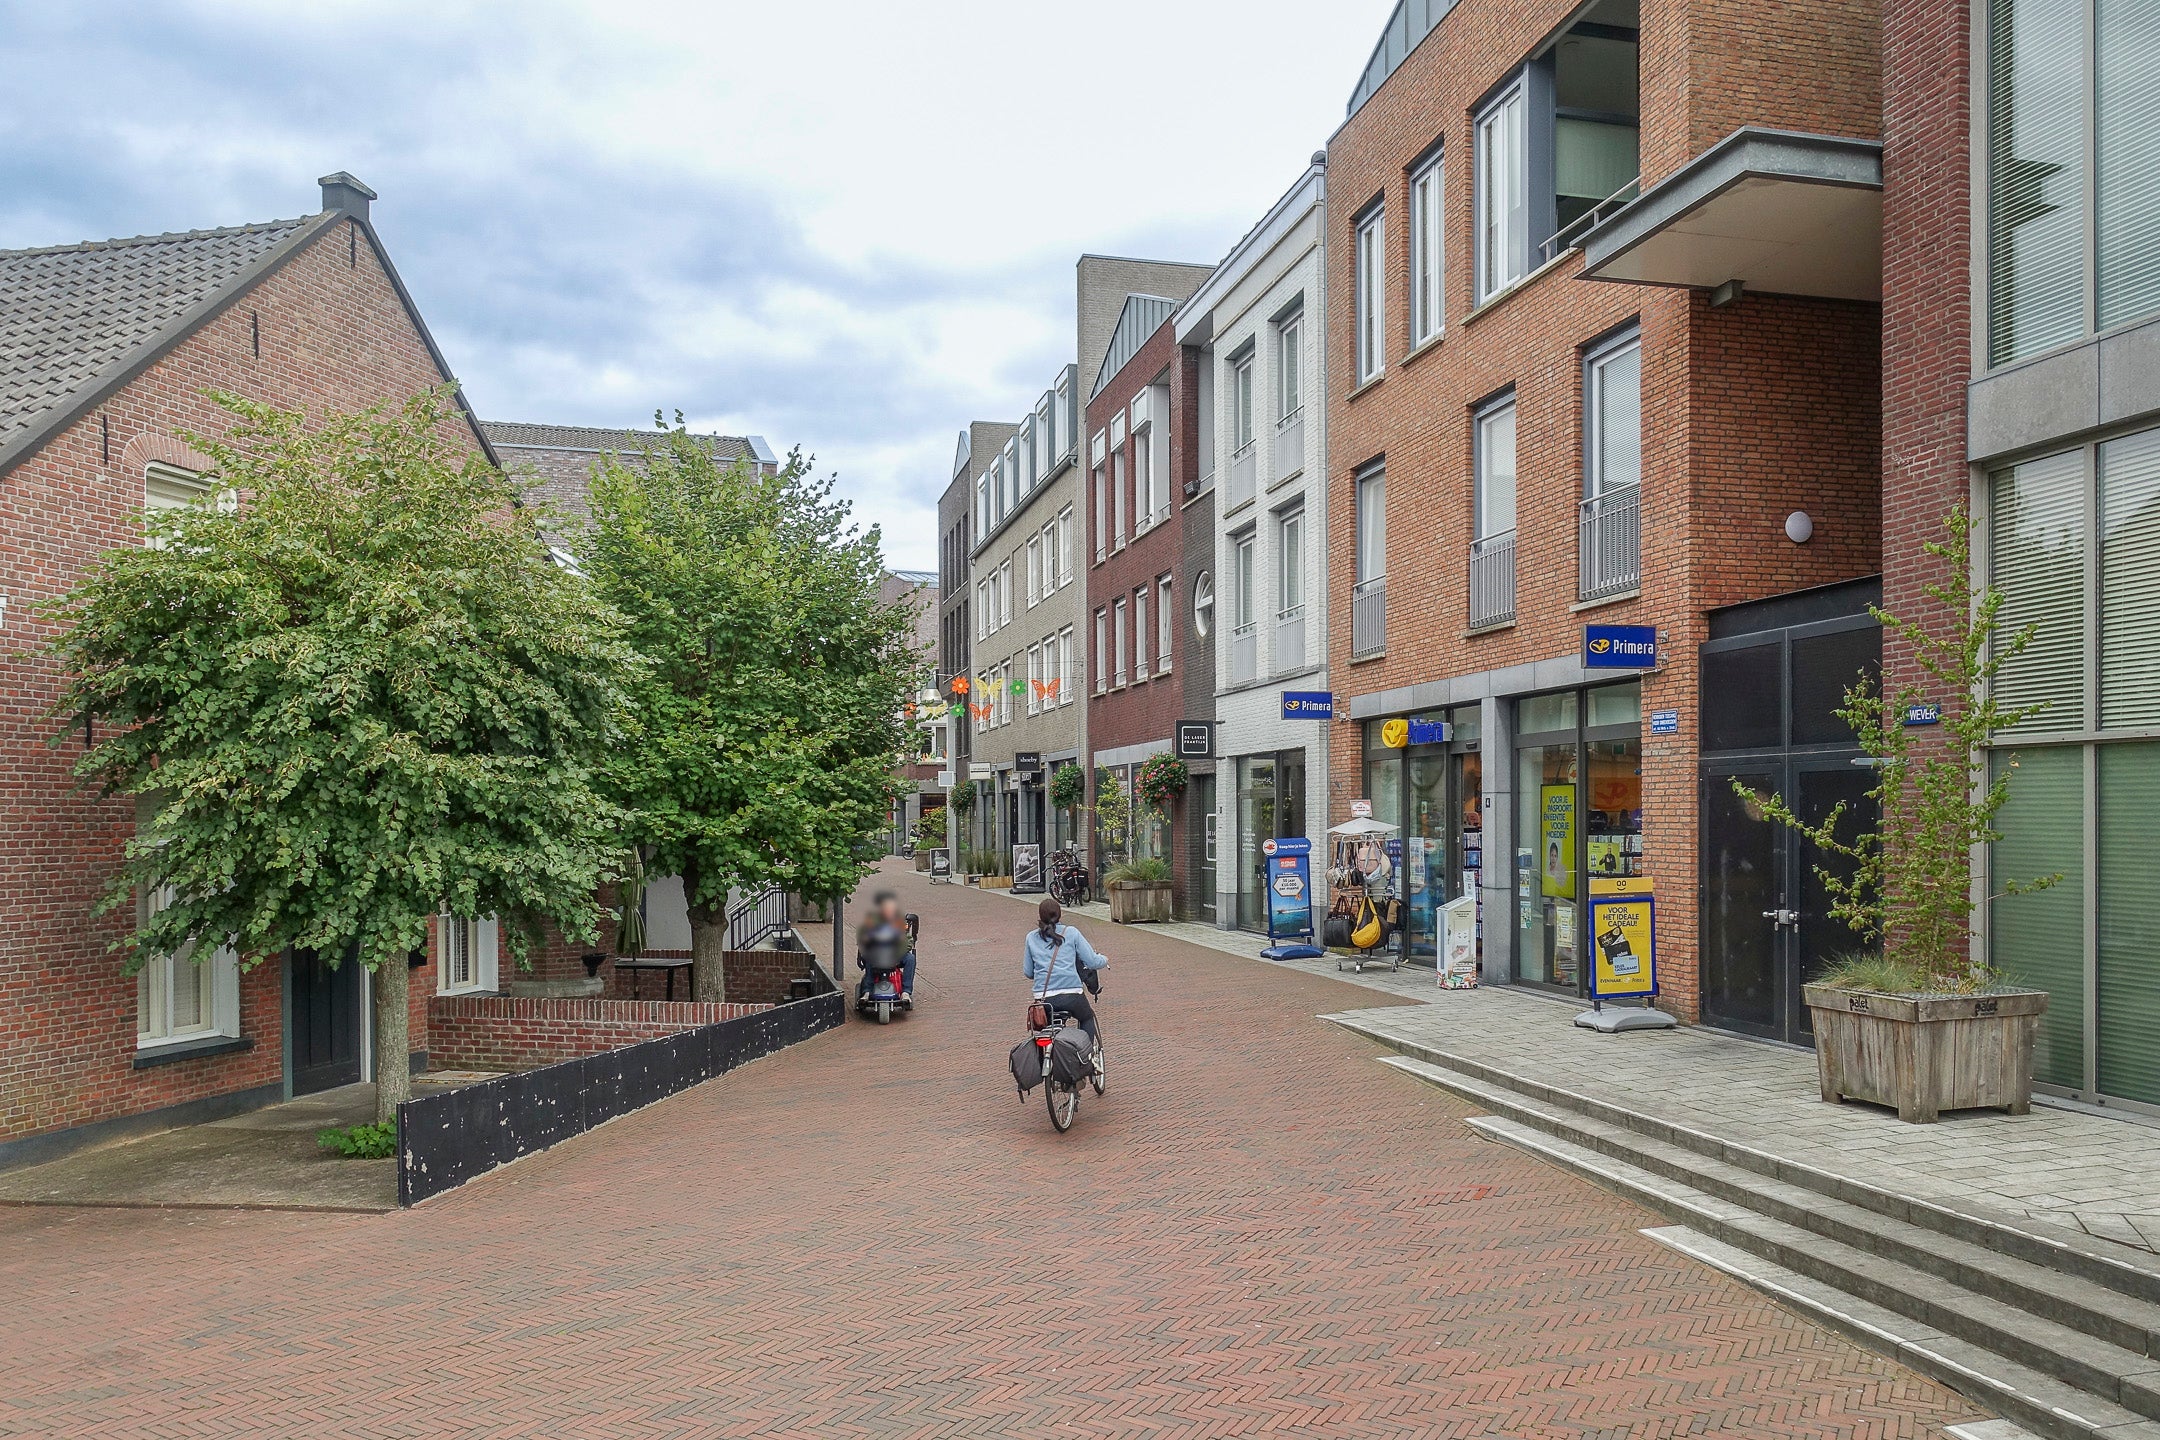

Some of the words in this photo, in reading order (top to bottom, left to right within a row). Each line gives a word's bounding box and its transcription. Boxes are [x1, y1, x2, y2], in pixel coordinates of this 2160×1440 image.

[1612, 639, 1654, 655] Primera
[1301, 700, 1331, 711] Primera
[1909, 708, 1936, 721] WEVER
[1603, 913, 1616, 921] HET
